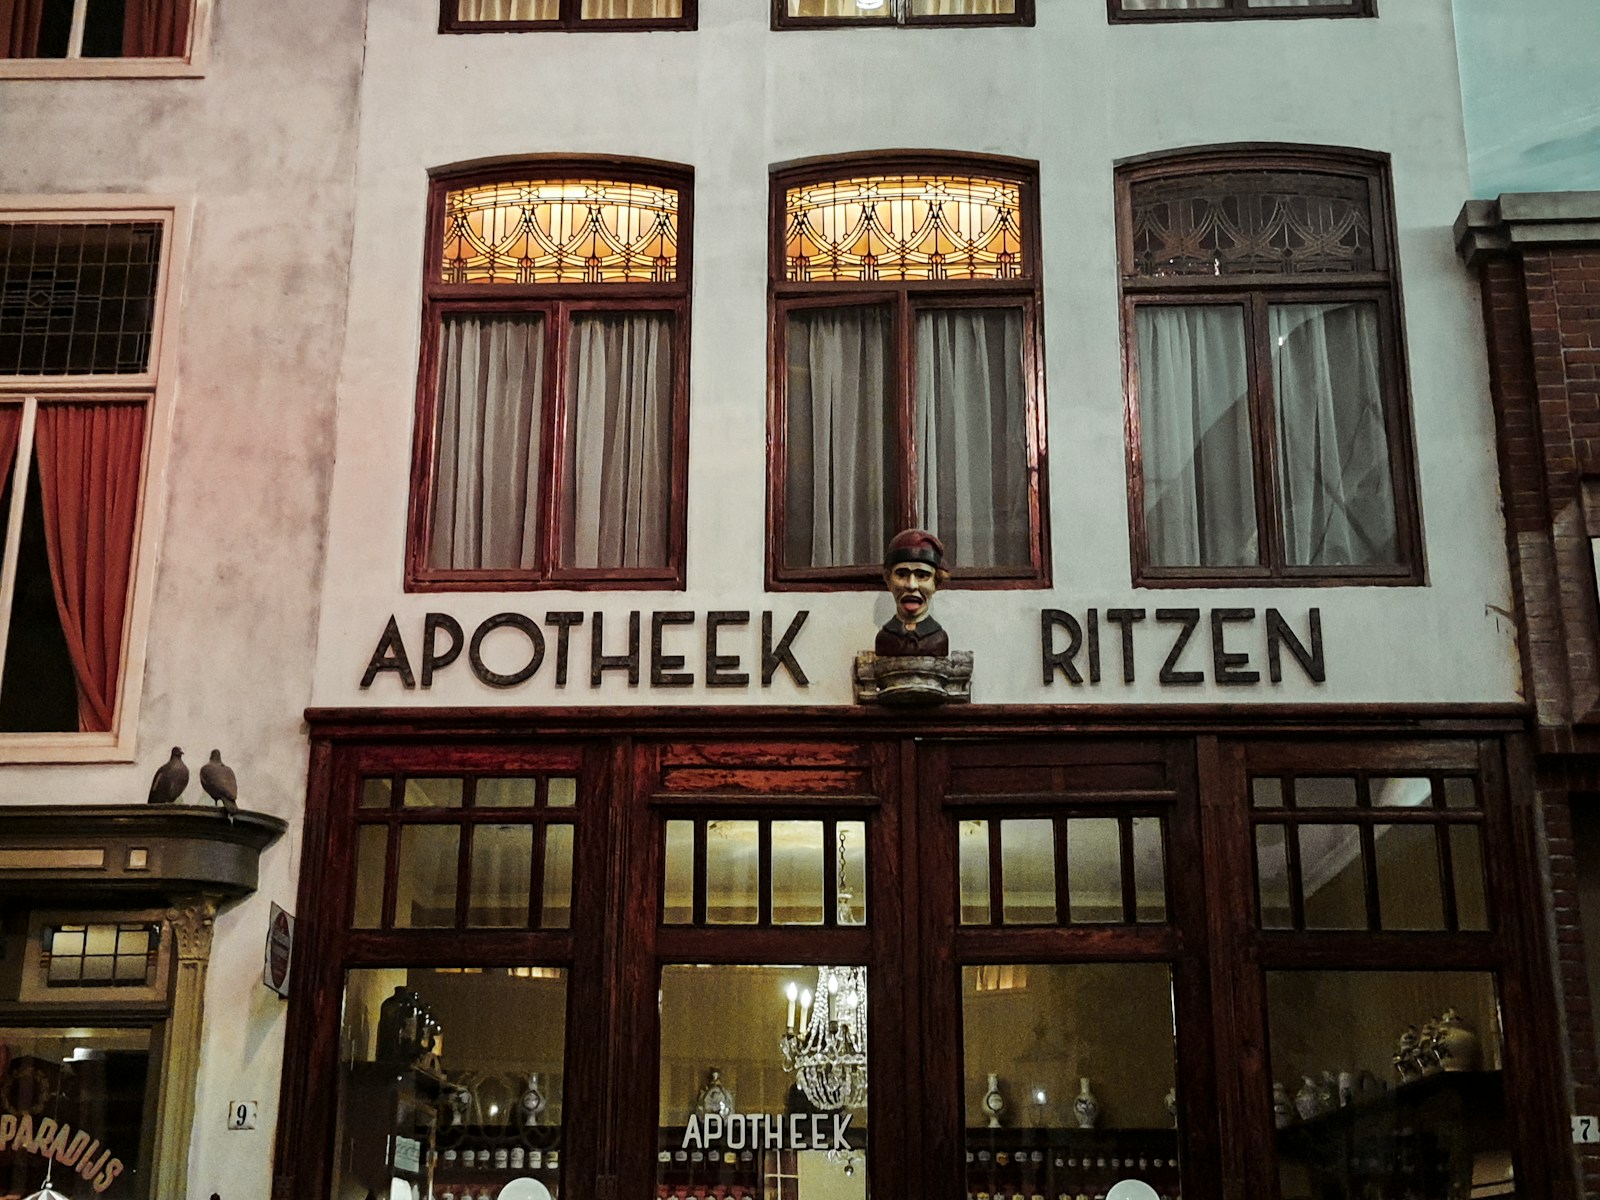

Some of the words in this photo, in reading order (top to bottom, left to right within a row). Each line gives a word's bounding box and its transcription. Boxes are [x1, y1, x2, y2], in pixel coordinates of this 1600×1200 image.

[360, 610, 809, 688] APOTHEEK
[1041, 607, 1326, 684] RITZEN
[236, 1104, 247, 1126] 9
[682, 1113, 853, 1149] APOTHEEK
[1580, 1119, 1591, 1141] 7
[0, 1114, 124, 1192] PARADIJS
